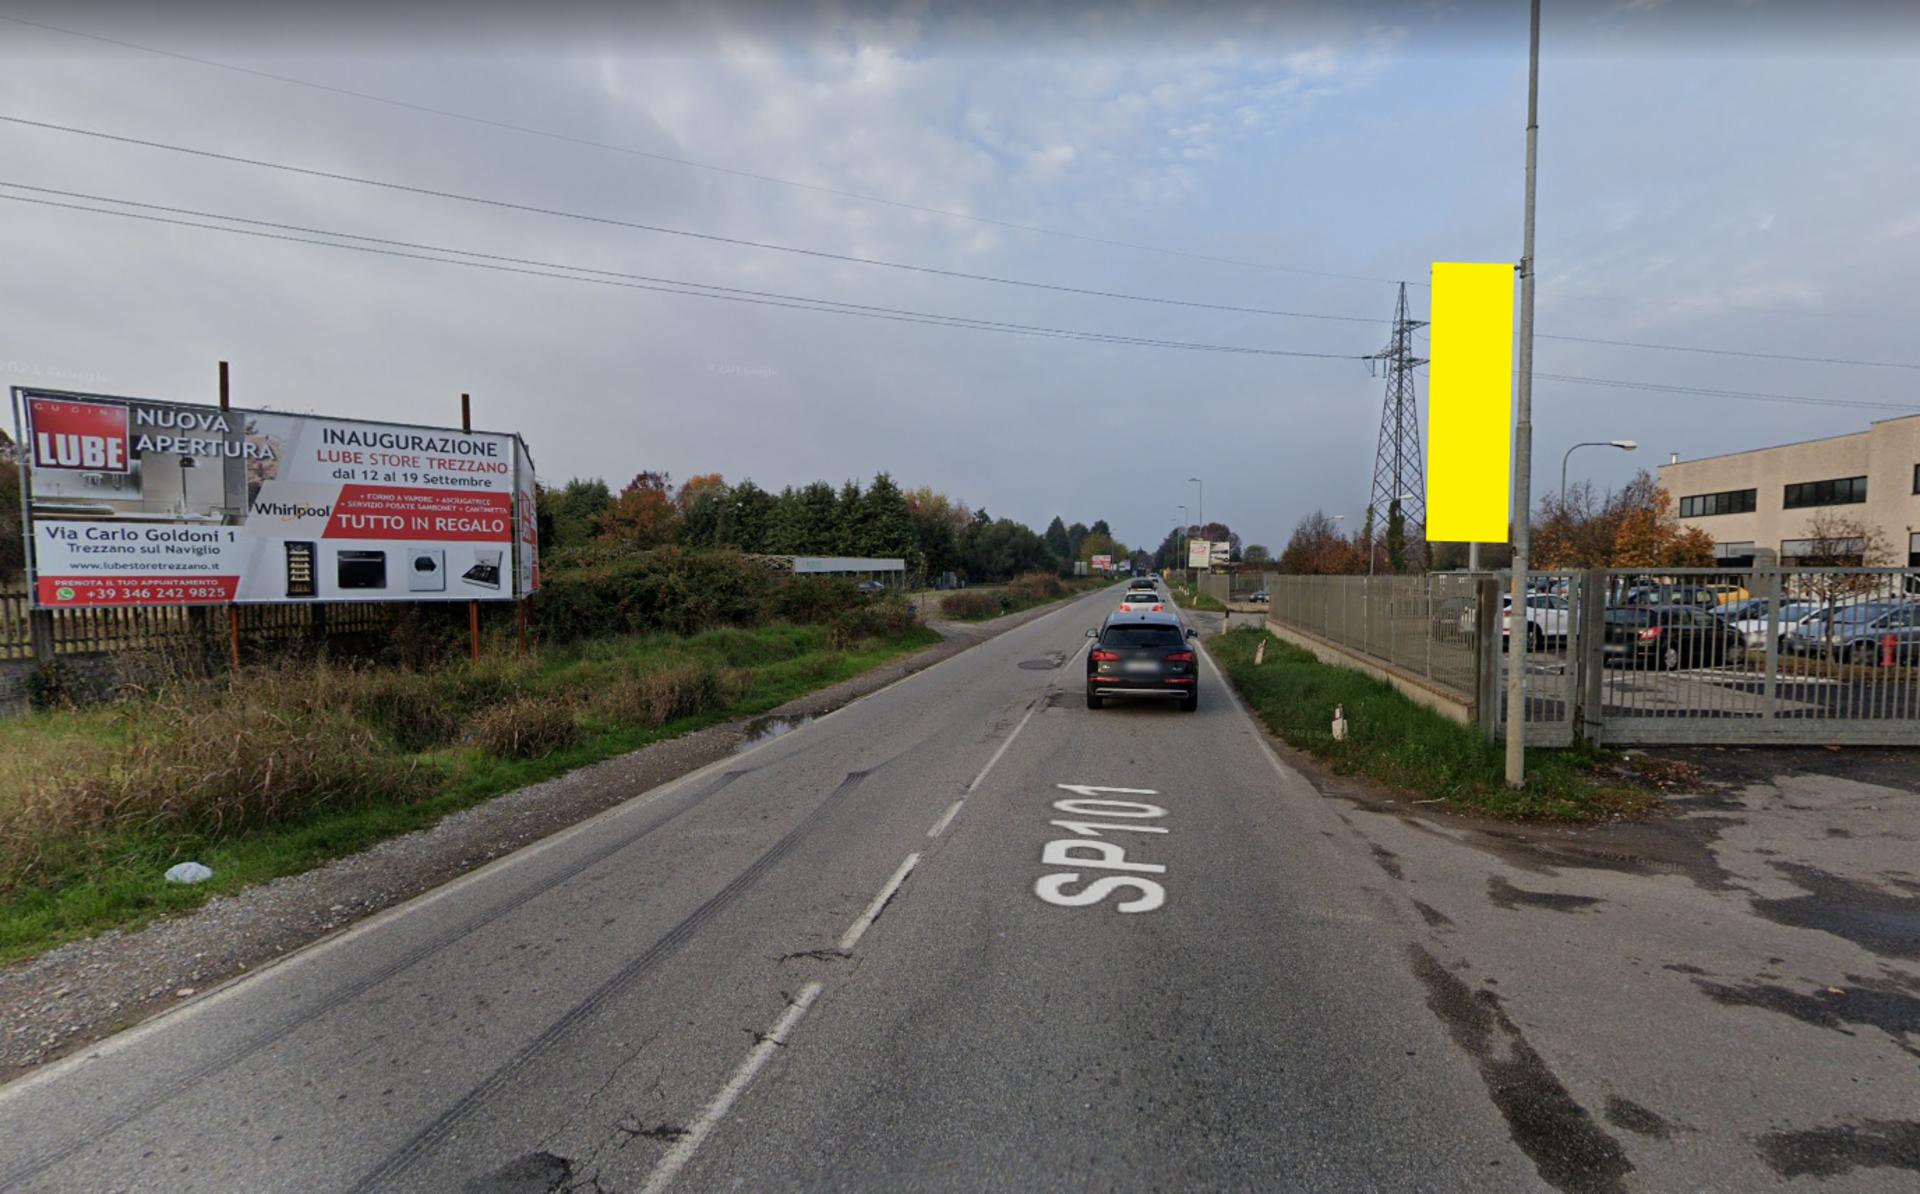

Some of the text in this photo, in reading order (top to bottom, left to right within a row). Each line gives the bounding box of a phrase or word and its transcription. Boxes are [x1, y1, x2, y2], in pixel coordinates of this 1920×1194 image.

[136, 408, 230, 432] NUOVA
[37, 432, 124, 469] LUBE
[136, 433, 276, 459] APERTURA
[323, 427, 498, 457] INAUGURAZIONE
[316, 449, 508, 474] LUBE STORE TREZZANO
[332, 468, 492, 488] dal 12 al 19 Settembre
[254, 502, 330, 520] Whirlpool
[336, 514, 504, 533] TUTTO IN REGALO
[45, 526, 235, 543] Via Carlo Goldoni 1
[67, 543, 221, 556] Trezzano sul Naviglio
[69, 562, 220, 570] www.lubestoretrezzano.it
[87, 588, 225, 599] +39 346 242 9825
